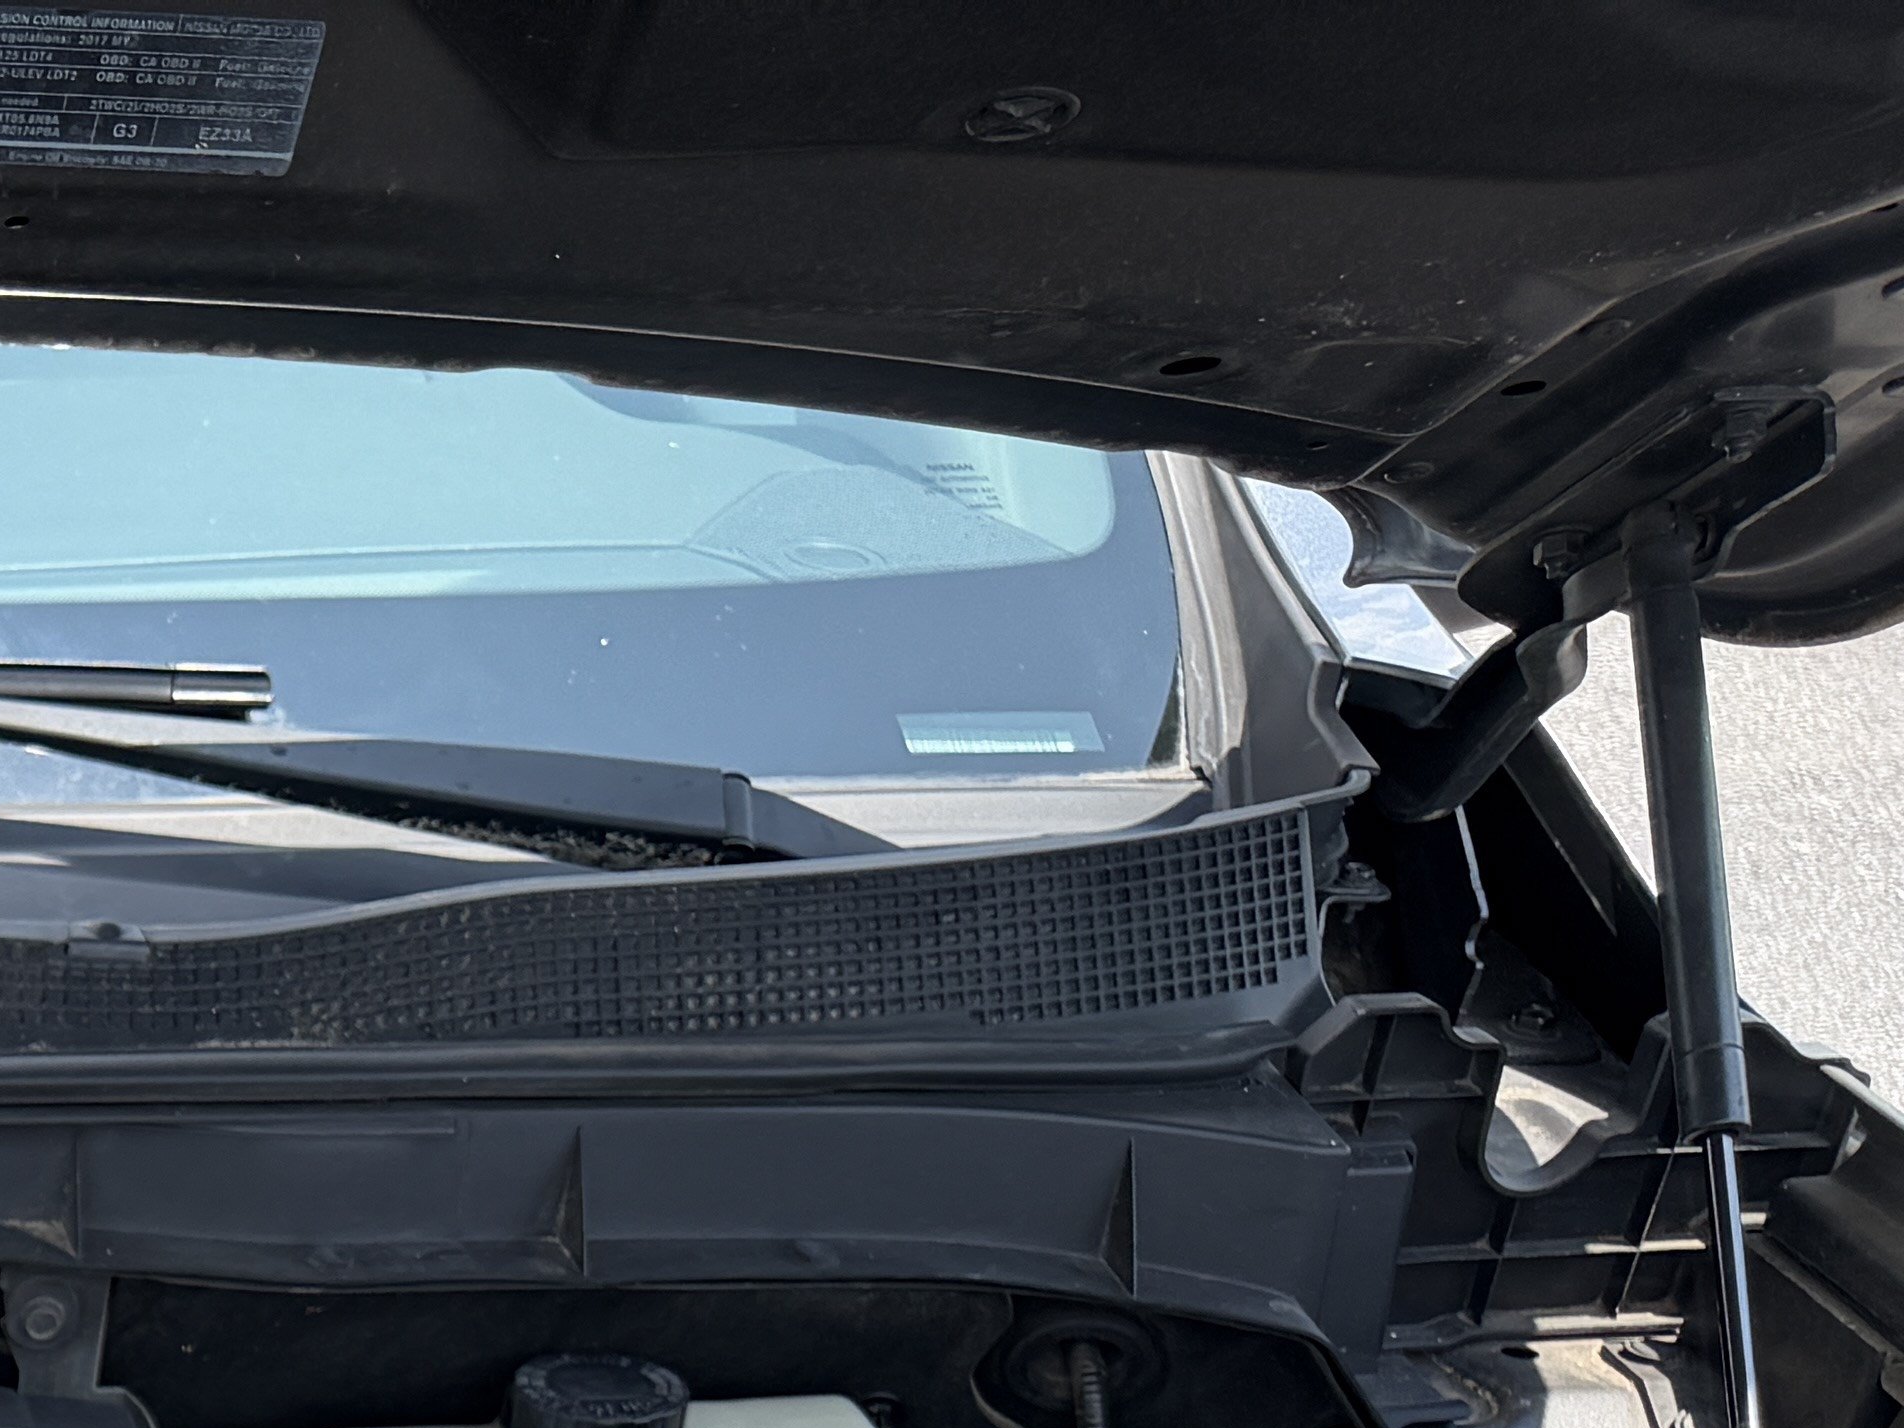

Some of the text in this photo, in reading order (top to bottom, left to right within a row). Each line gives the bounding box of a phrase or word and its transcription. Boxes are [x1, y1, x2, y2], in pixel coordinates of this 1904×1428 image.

[32, 14, 88, 27] CONTROL
[90, 17, 176, 31] INFORMATION
[78, 34, 109, 46] 2017
[139, 55, 158, 67] CA
[135, 72, 154, 84] CA
[112, 122, 139, 139] G3
